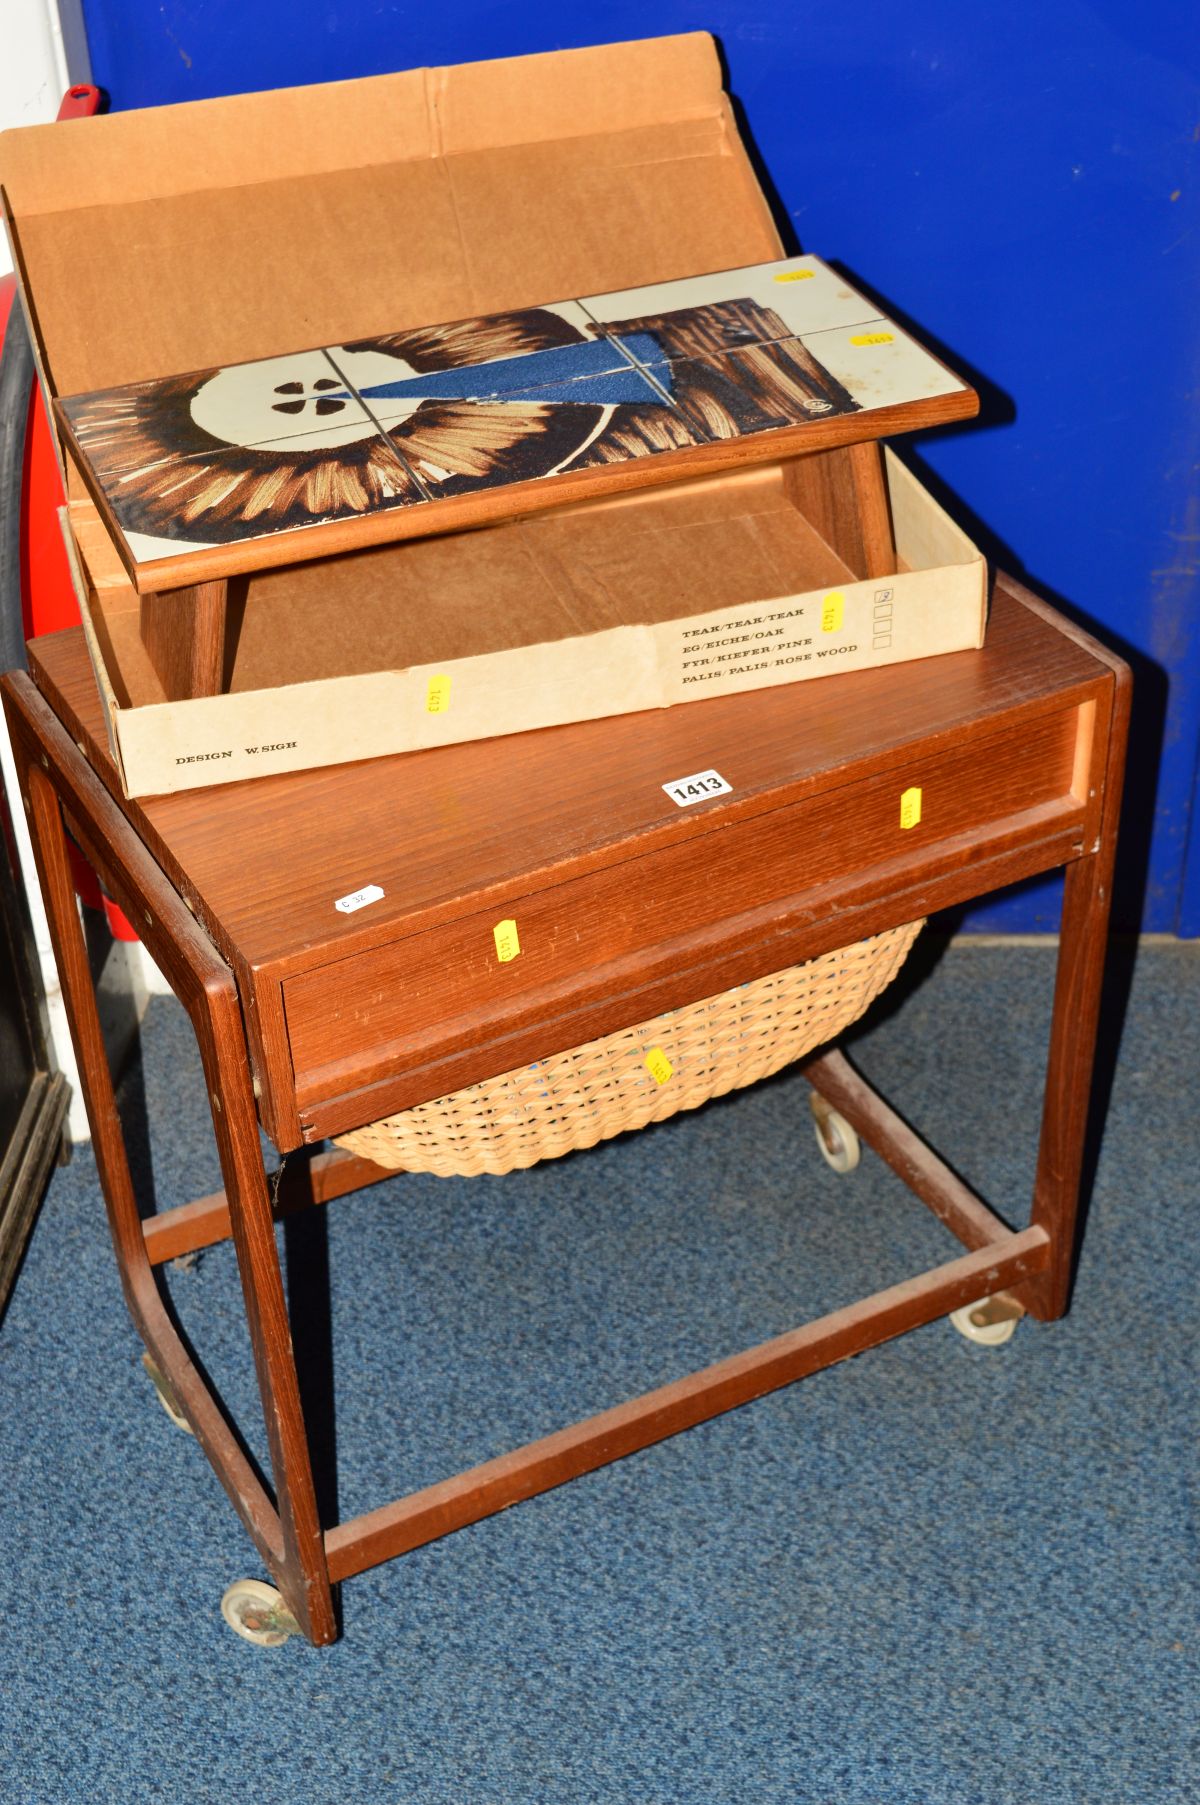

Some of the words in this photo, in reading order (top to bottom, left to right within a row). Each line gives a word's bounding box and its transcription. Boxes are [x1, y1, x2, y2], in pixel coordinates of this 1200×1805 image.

[682, 608, 805, 638] TEAK/TEAK/TEAK
[822, 608, 836, 632] 1413
[682, 628, 785, 654] EG/EICHE/OAK
[816, 644, 859, 659] WOOD
[682, 638, 814, 669] FYR/KIEFER/PINE
[428, 689, 442, 713] 1413
[175, 750, 233, 765] DESIGN
[674, 777, 722, 799] 1413
[352, 894, 367, 904] 32
[499, 935, 512, 961] 1413
